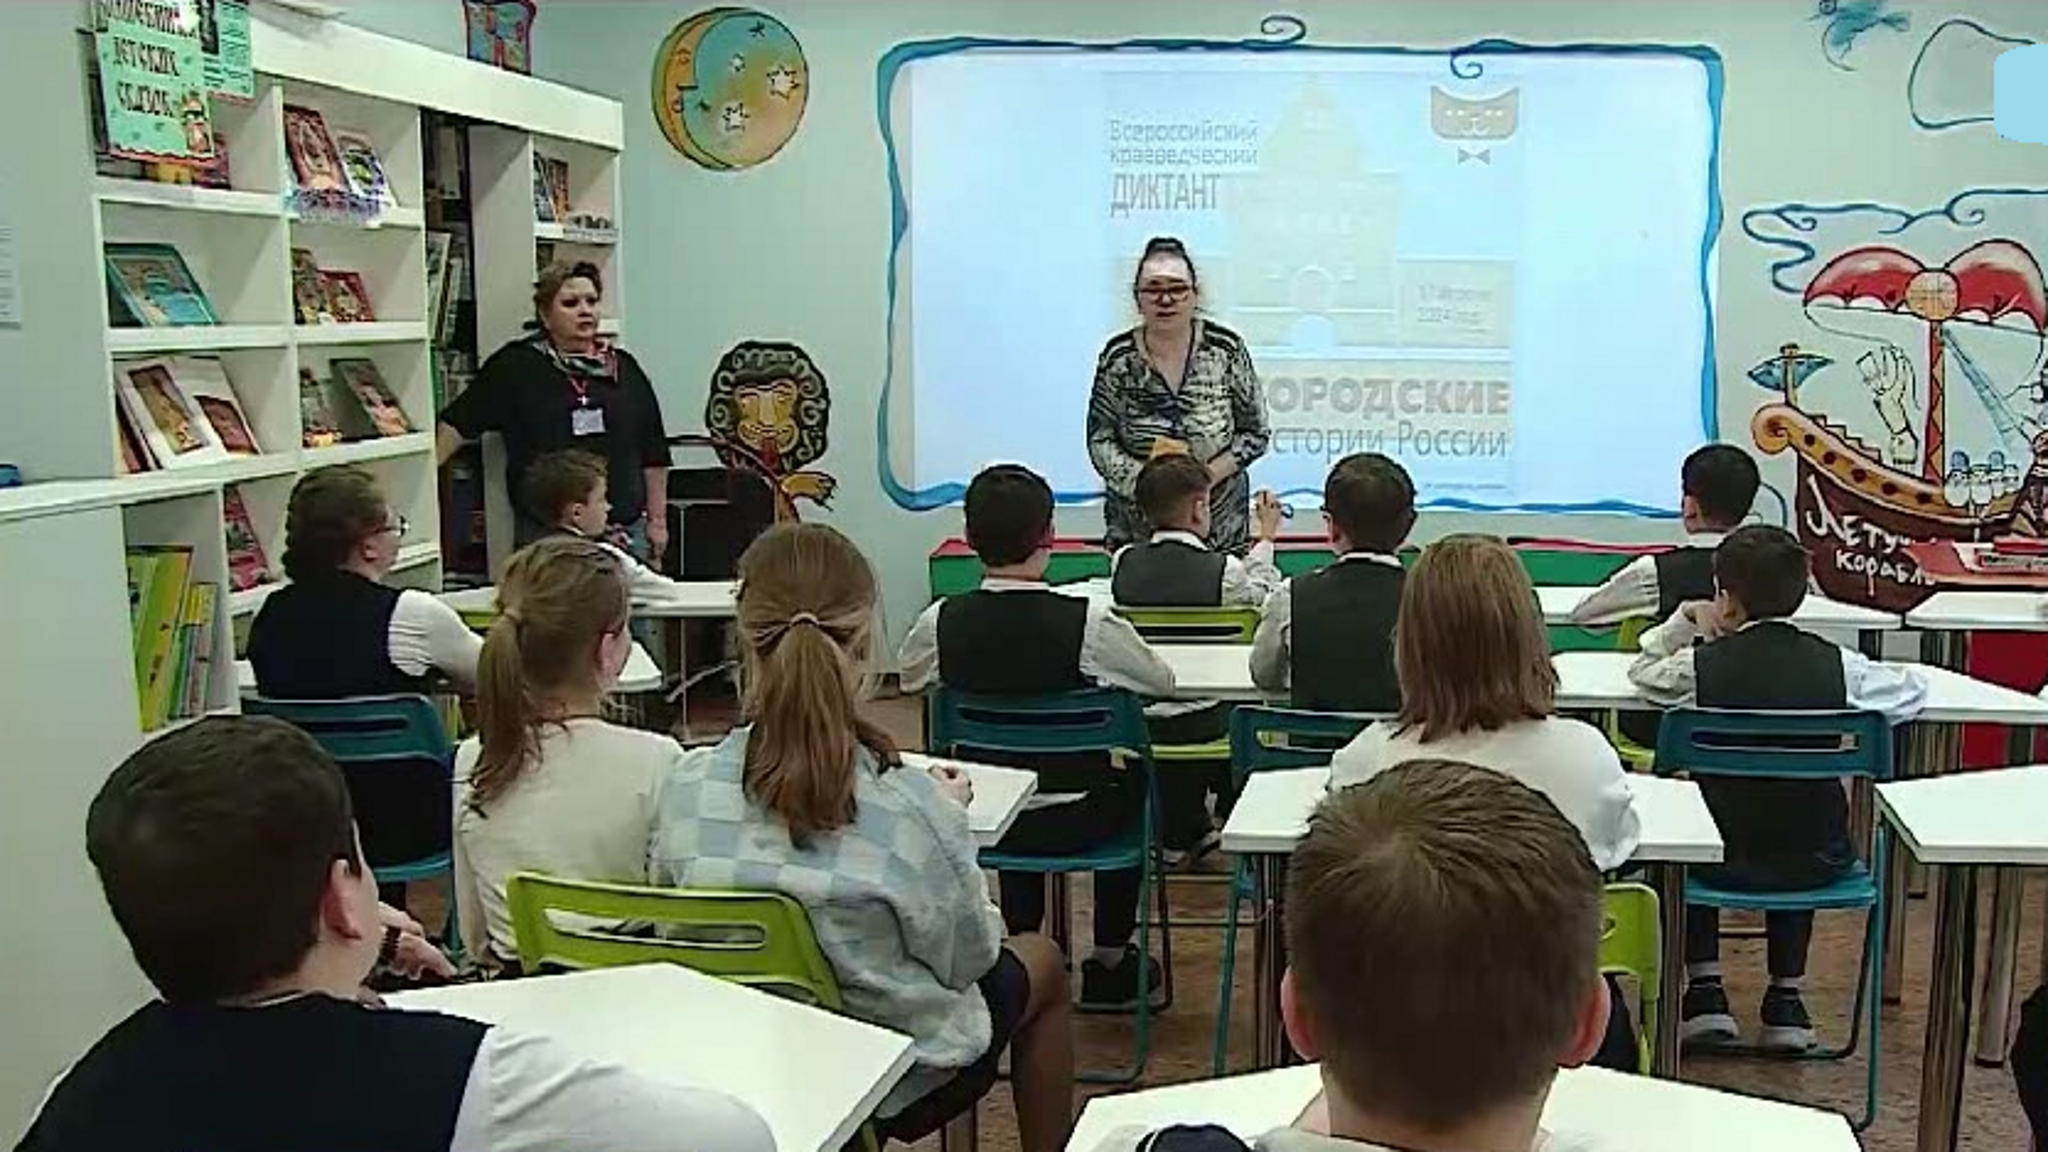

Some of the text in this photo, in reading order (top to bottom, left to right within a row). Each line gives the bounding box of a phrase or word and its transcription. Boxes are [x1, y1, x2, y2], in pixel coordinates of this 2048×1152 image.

[1110, 119, 1258, 144] Всероссийский
[1110, 143, 1258, 166] краеведческий
[1110, 172, 1221, 218] ДИКТАНТ
[1266, 376, 1510, 420] ОРОДСКИЕ
[1273, 420, 1507, 464] стории России
